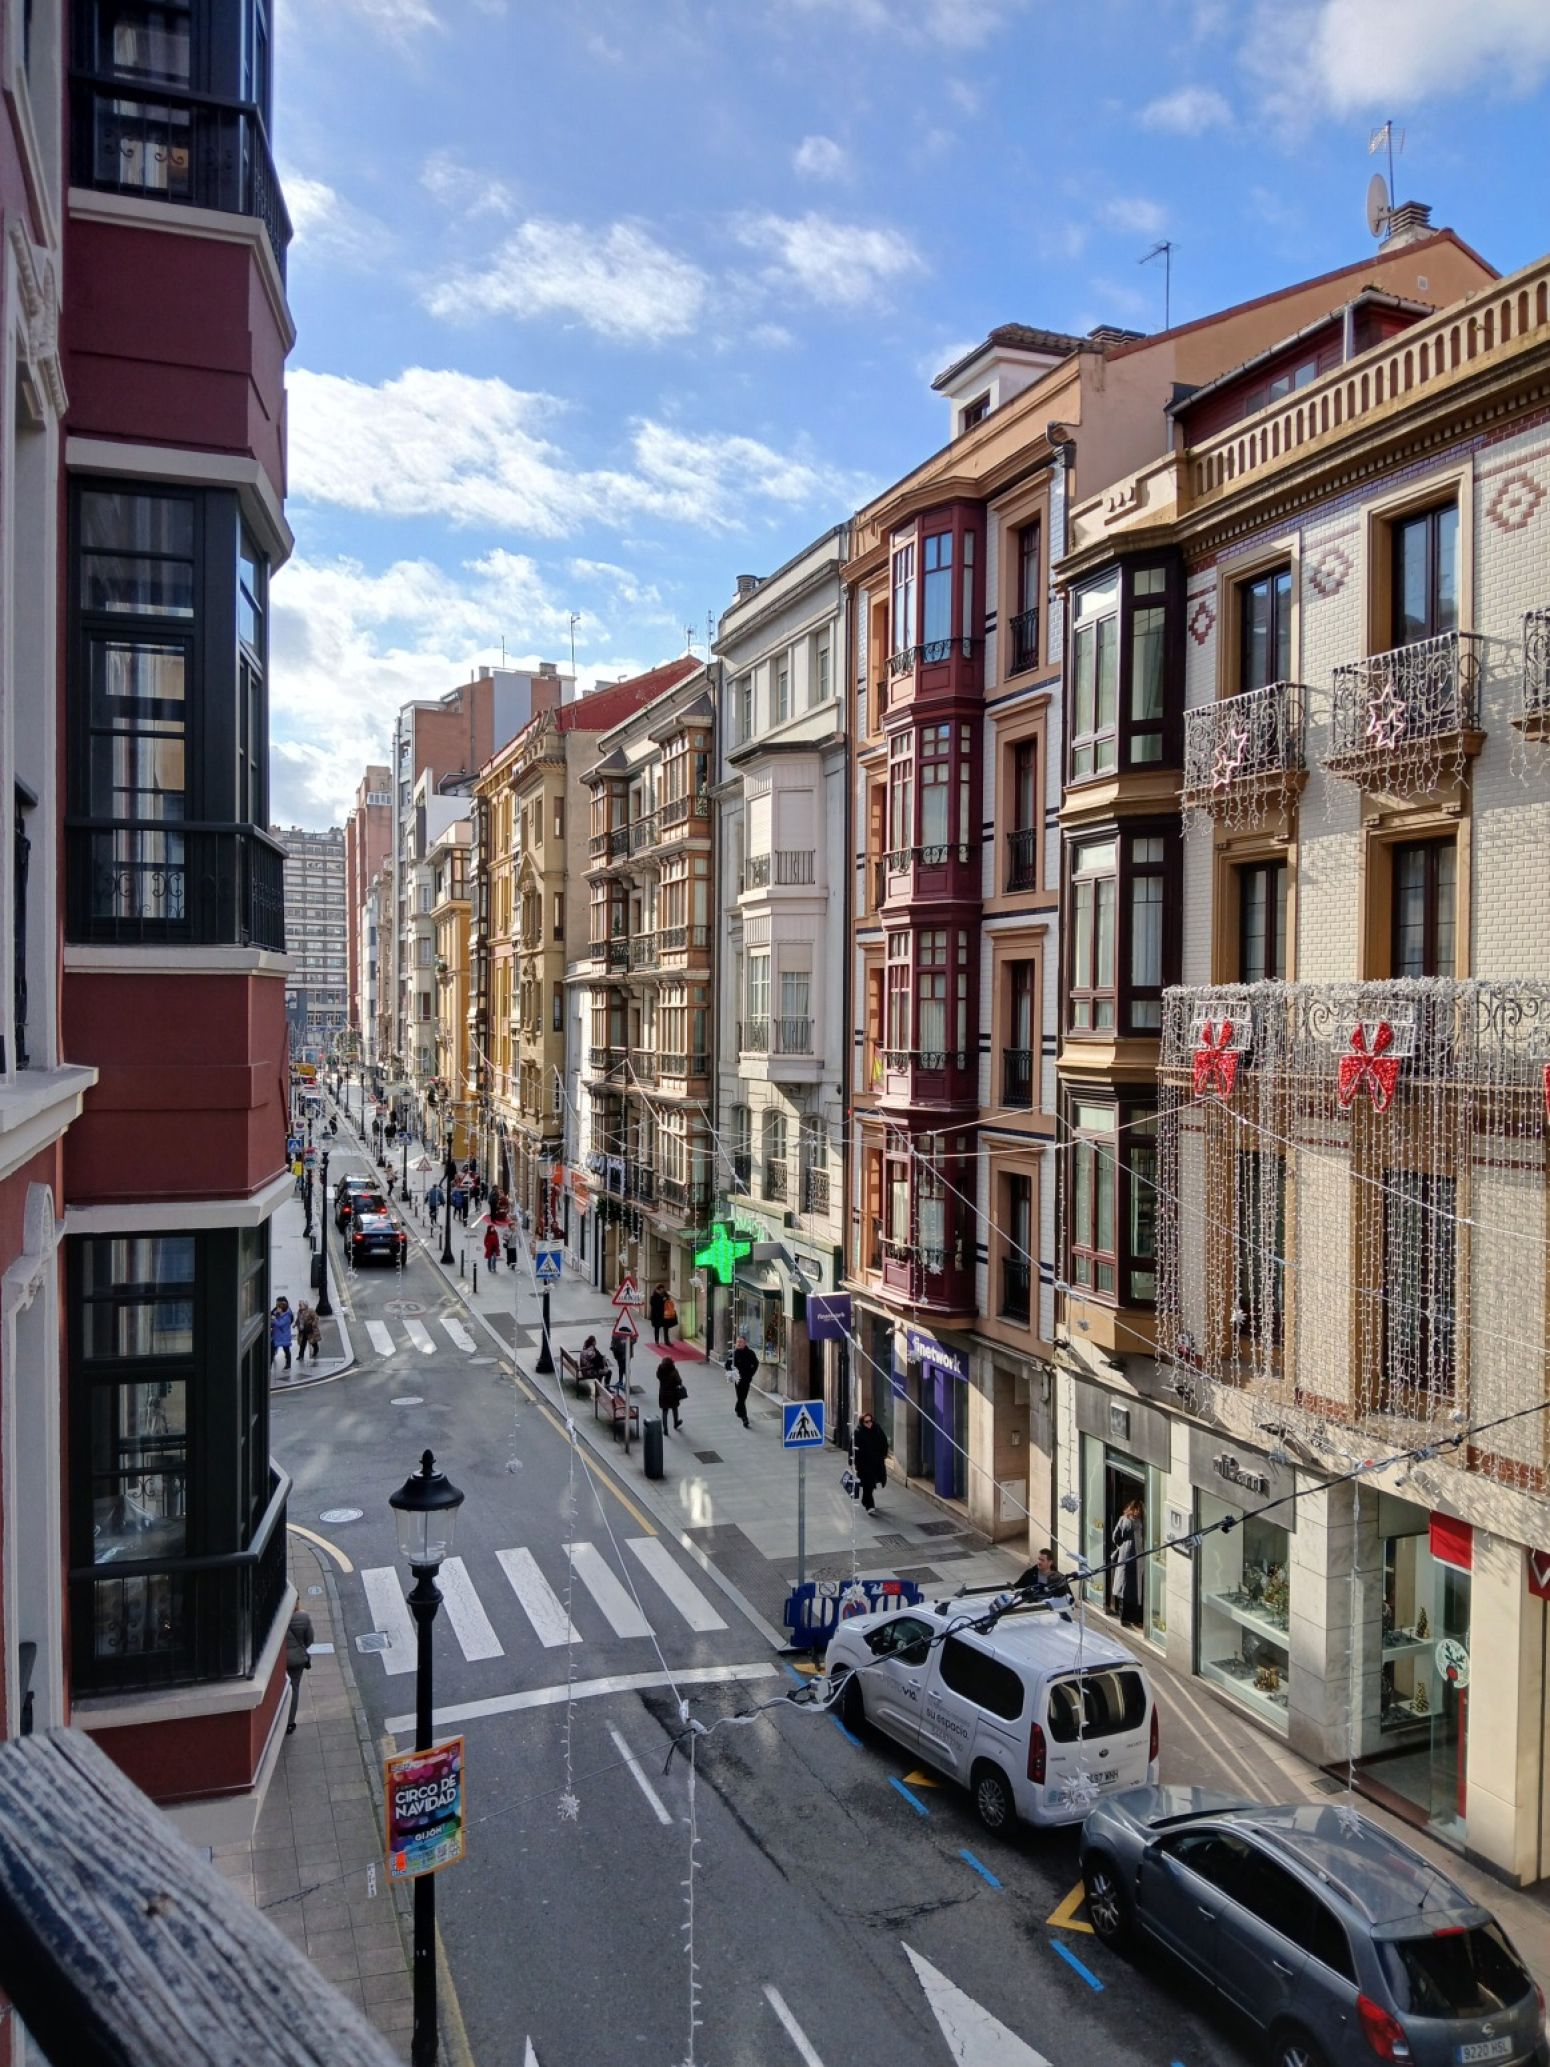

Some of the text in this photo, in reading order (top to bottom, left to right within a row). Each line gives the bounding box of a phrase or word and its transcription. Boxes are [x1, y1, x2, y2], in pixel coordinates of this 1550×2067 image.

[913, 1335, 962, 1375] finetwork
[926, 1708, 936, 1720] su
[395, 1774, 457, 1804] CIRCO DE
[395, 1788, 457, 1820] NAVIDAD
[1464, 2044, 1489, 2060] 9220
